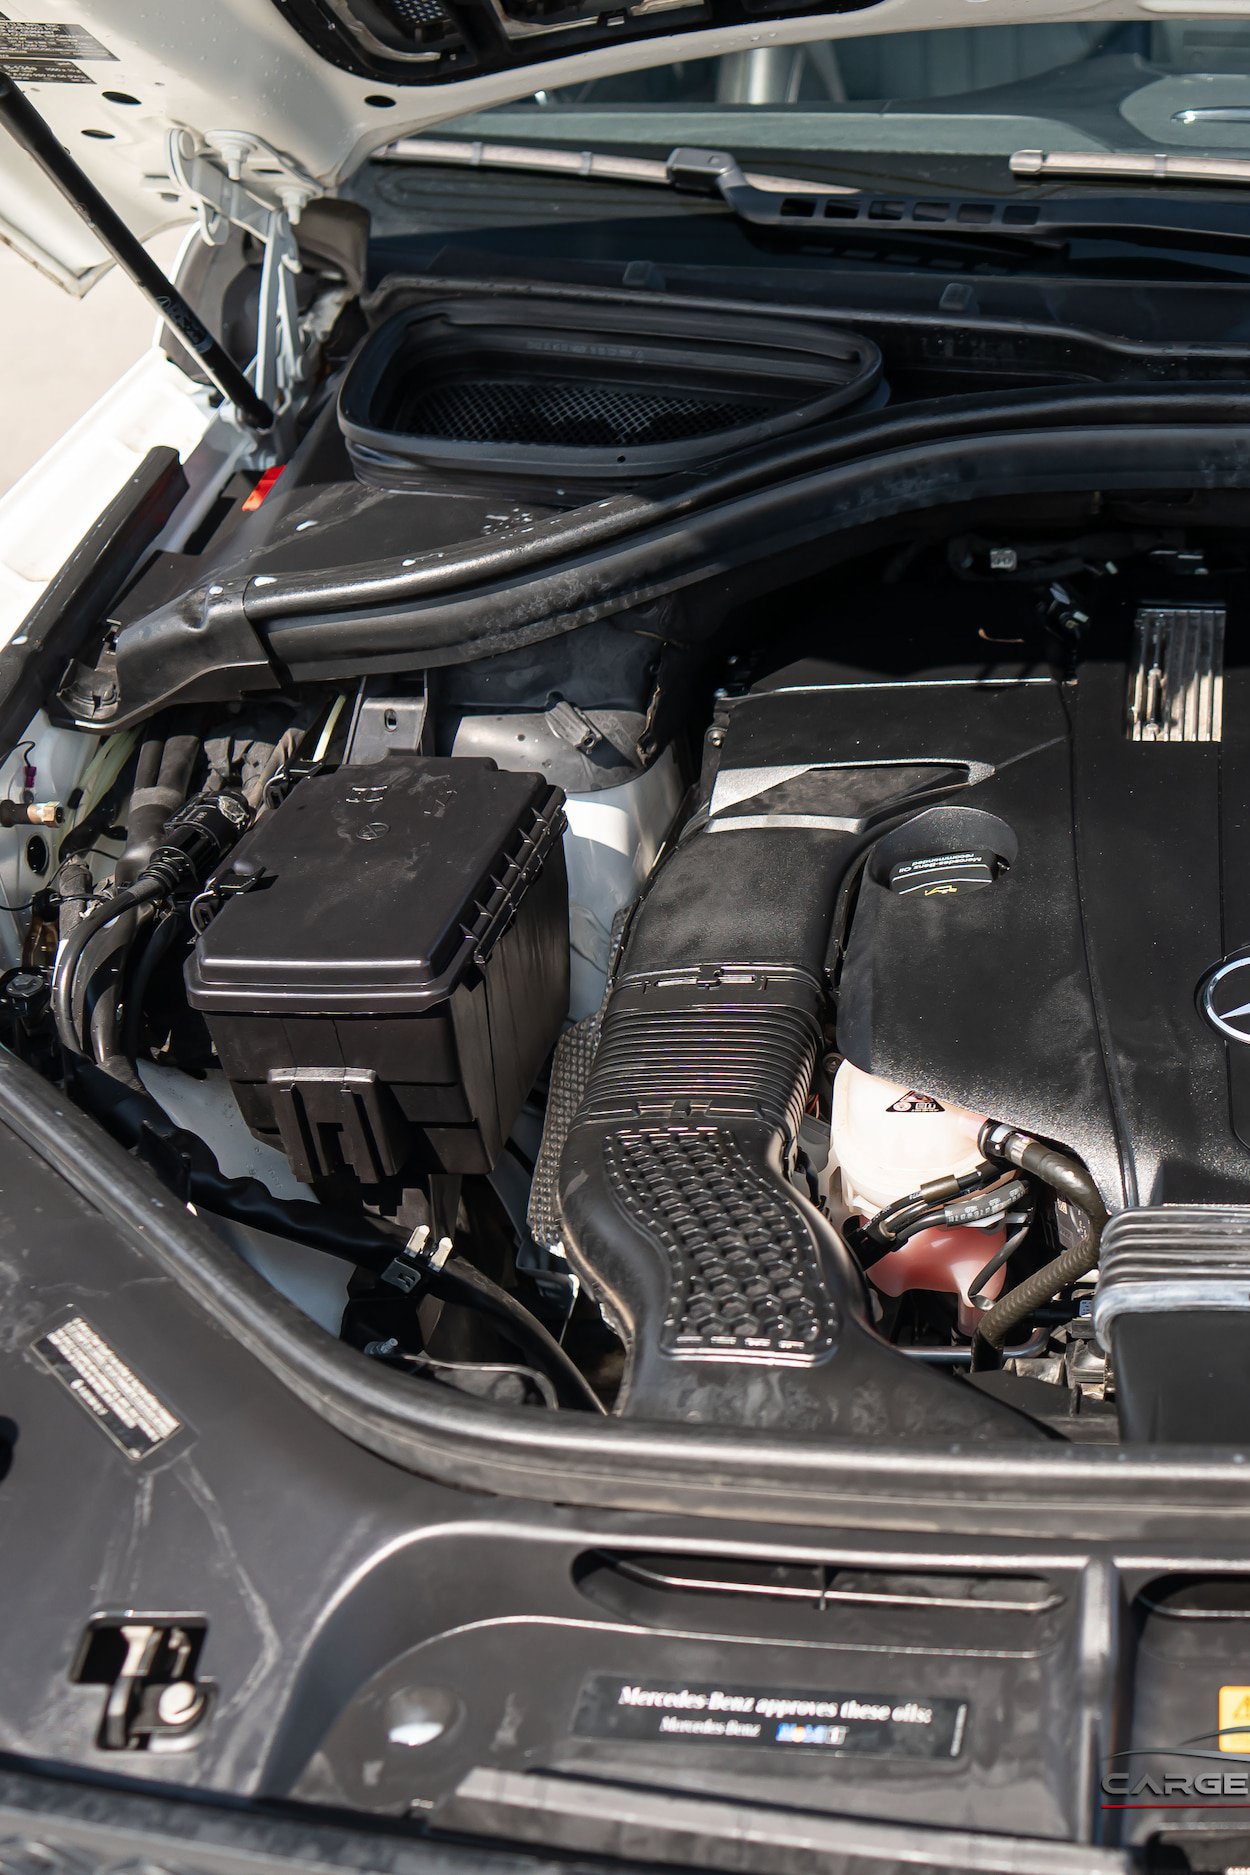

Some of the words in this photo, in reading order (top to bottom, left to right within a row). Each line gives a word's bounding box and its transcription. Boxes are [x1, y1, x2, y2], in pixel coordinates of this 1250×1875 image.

[911, 854, 975, 867] recommended
[913, 857, 982, 869] Mercedes-Benz
[618, 1685, 756, 1713] Mercedes-Benz
[756, 1696, 838, 1719] approves
[841, 1699, 891, 1722] these
[891, 1702, 933, 1725] oils:
[659, 1715, 761, 1738] Mercedes-Benz
